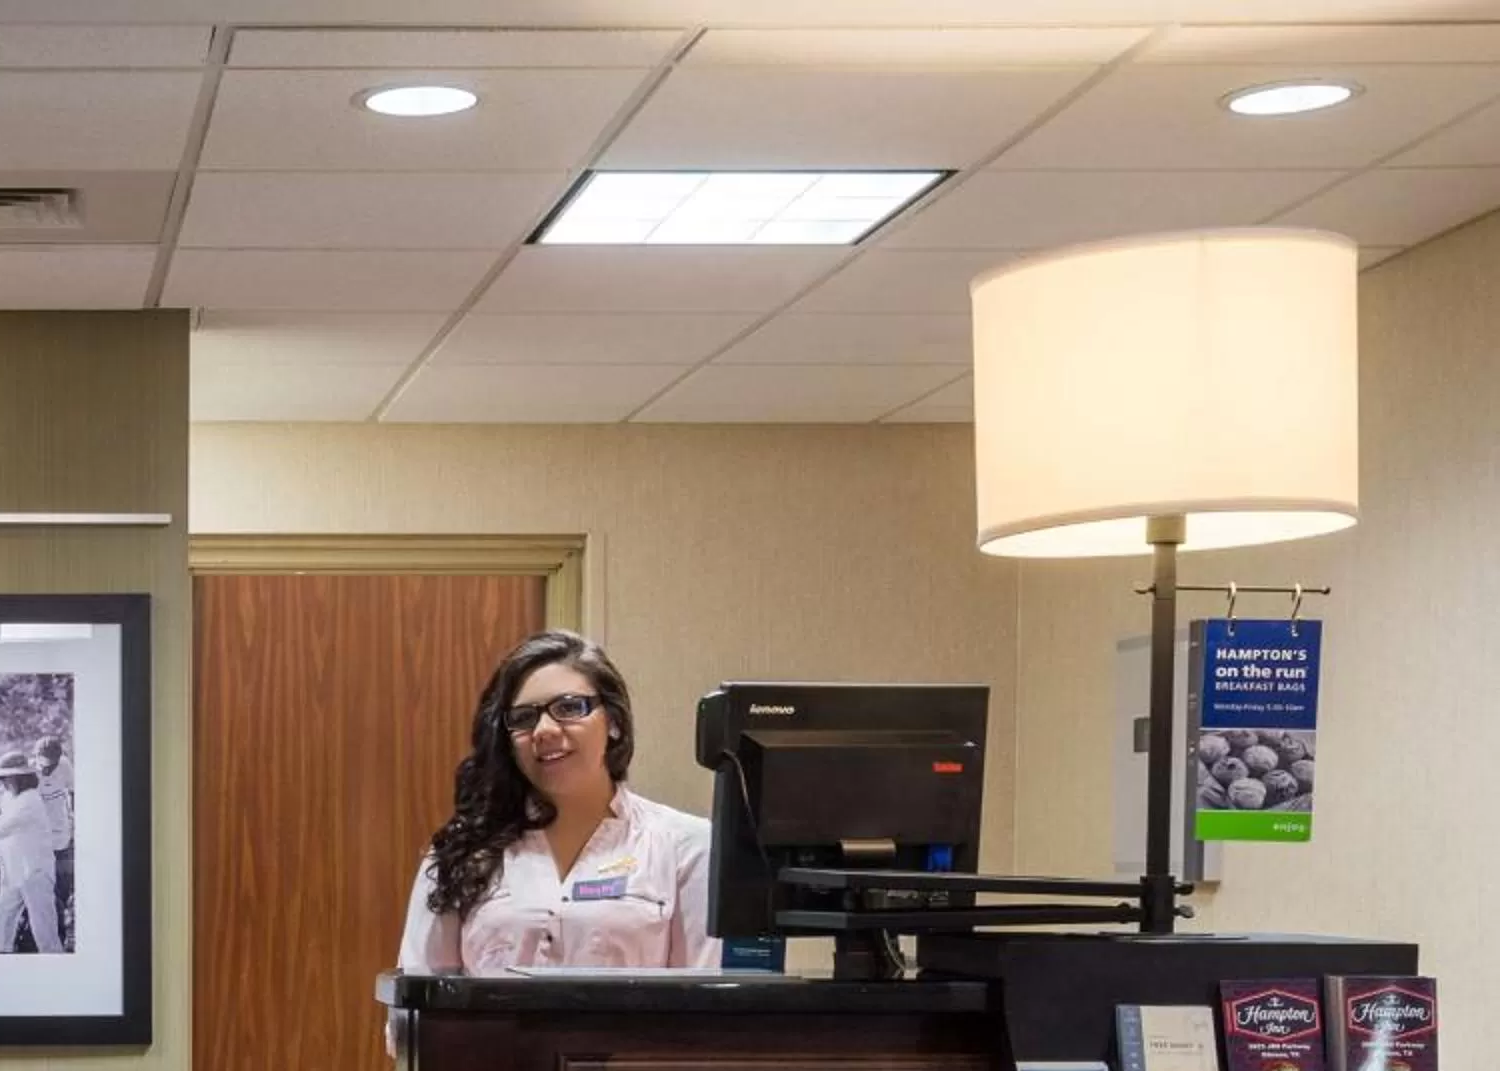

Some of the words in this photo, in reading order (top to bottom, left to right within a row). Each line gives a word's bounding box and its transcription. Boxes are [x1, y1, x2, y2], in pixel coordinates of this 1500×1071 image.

[1216, 648, 1308, 660] HAMPTON'S
[1215, 666, 1239, 677] on
[1242, 663, 1272, 678] the
[1275, 667, 1306, 679] run
[1215, 681, 1273, 692] BREAKFAST
[1277, 682, 1305, 693] BAGS
[749, 703, 796, 715] lenovo
[1238, 1006, 1316, 1025] Hampton
[1352, 1003, 1431, 1022] Hampton
[1259, 1022, 1291, 1035] Inn
